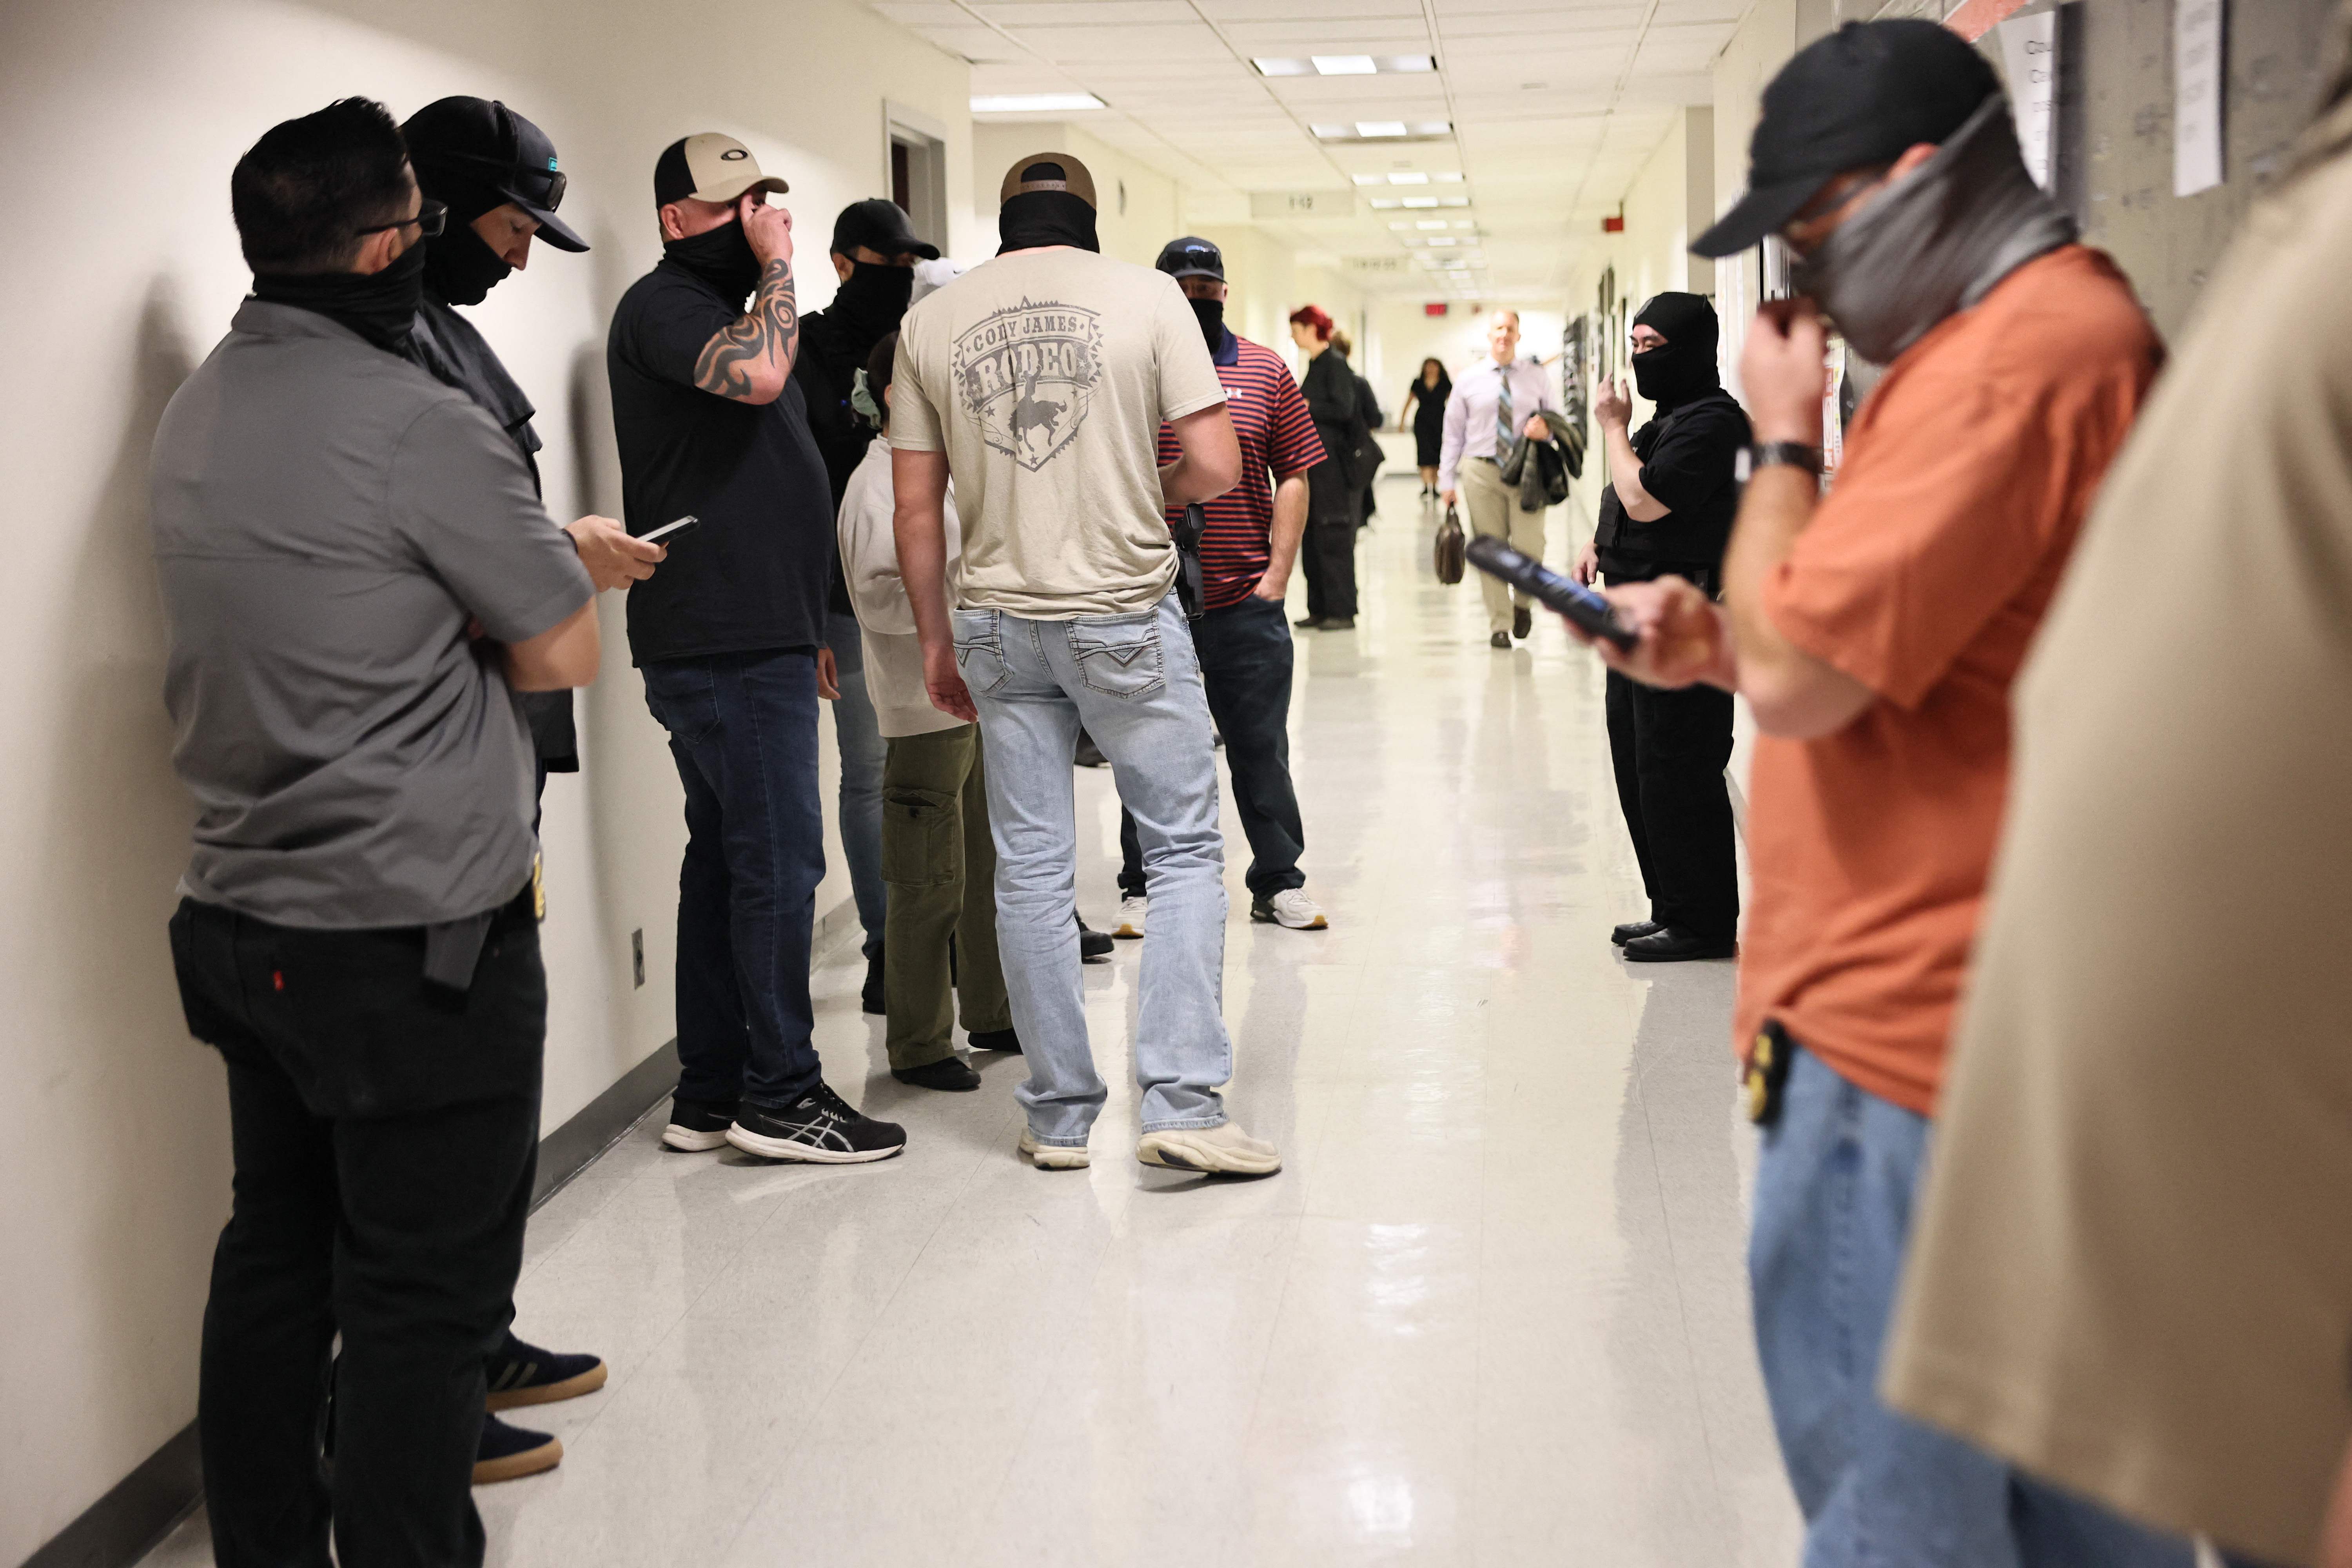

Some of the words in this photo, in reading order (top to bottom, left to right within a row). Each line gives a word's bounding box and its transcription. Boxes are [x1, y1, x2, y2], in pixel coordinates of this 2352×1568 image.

[973, 321, 1017, 352] CODY
[1023, 316, 1077, 334] JAMES
[975, 342, 1077, 398] RODEO
